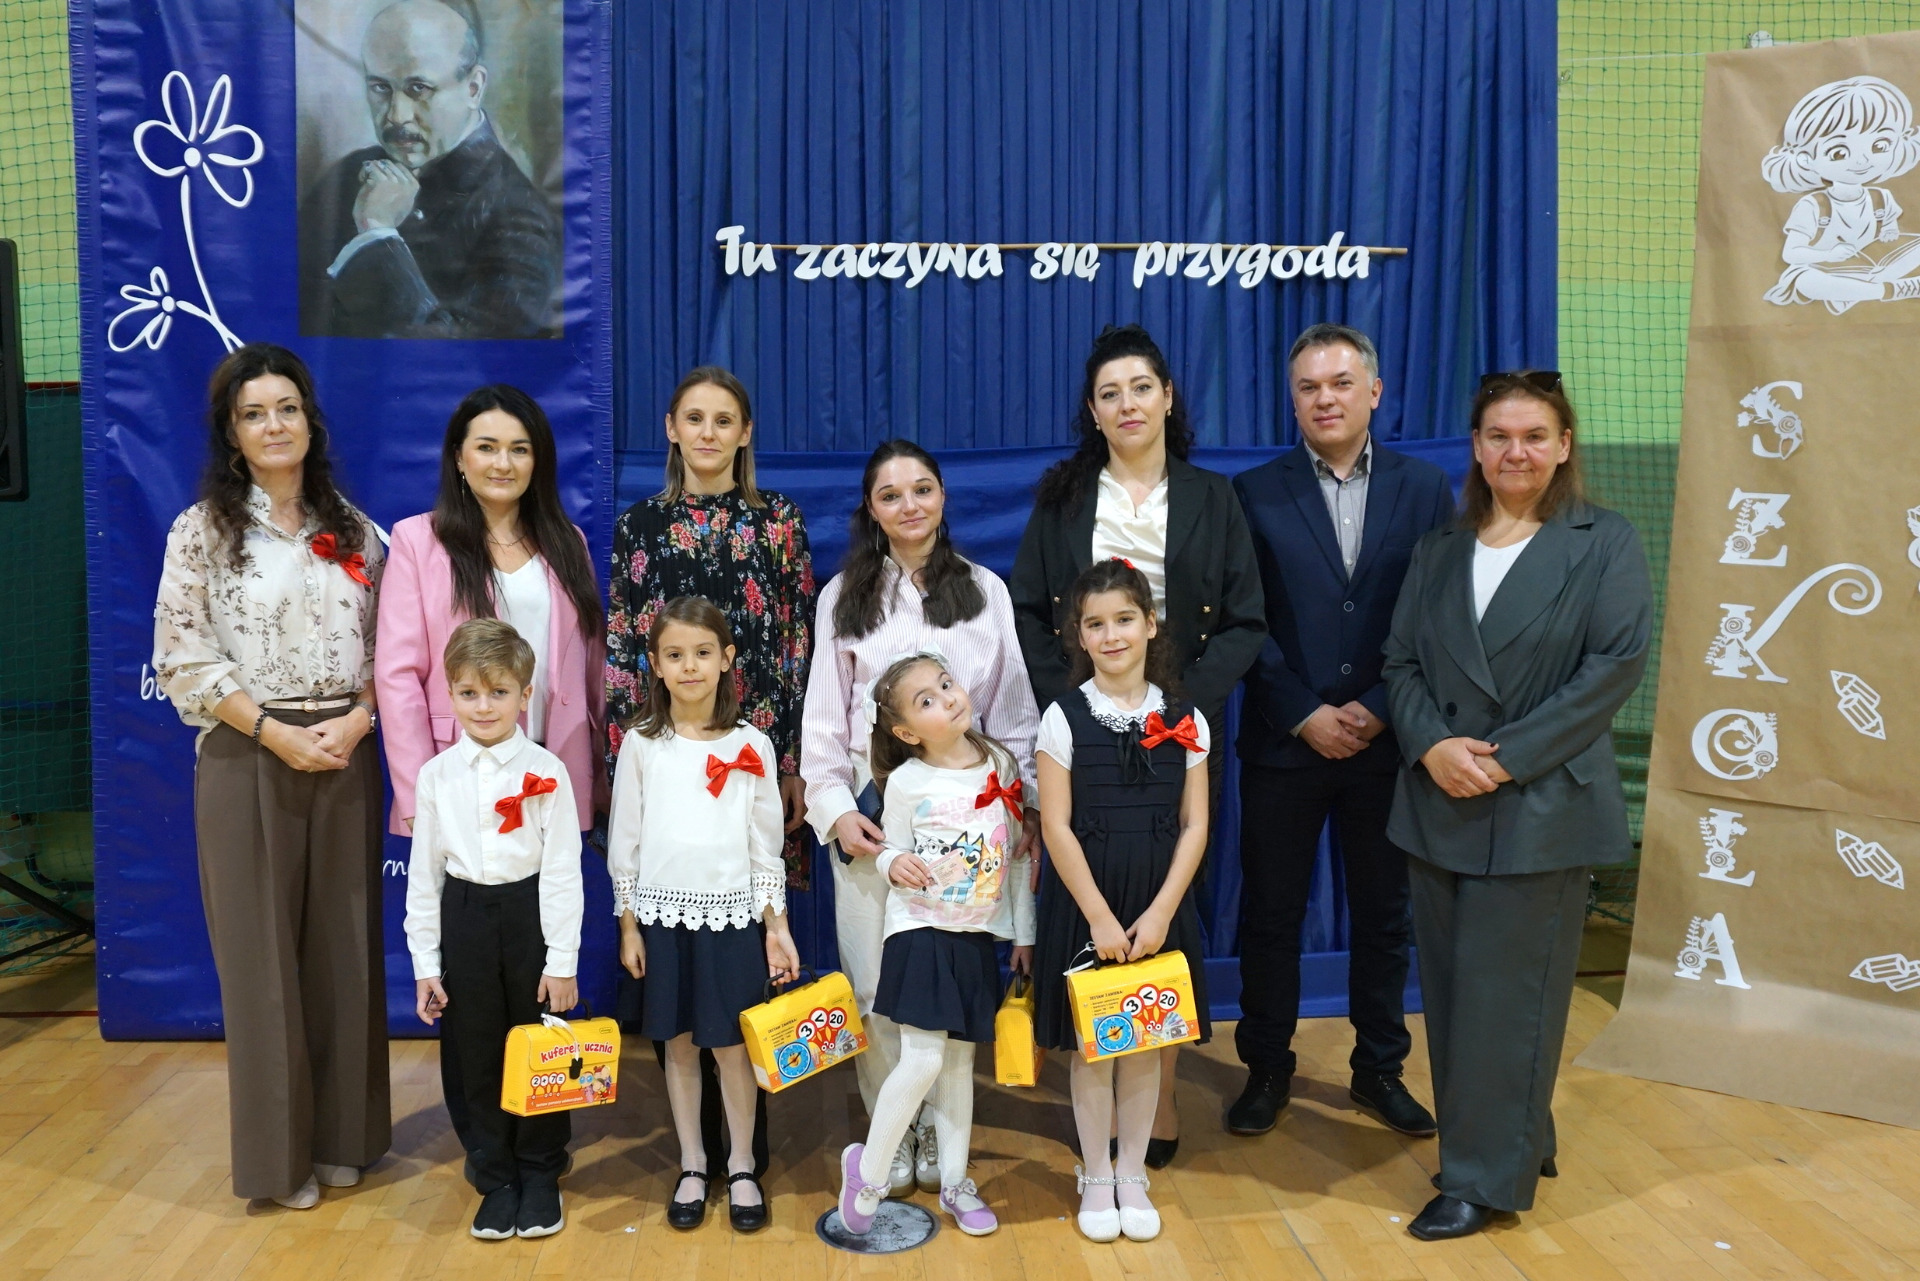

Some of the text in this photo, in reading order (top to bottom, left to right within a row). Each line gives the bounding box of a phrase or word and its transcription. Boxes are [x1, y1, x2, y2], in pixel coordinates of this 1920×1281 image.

[715, 225, 777, 277] Tu
[793, 242, 1004, 289] zaczyna
[1133, 231, 1370, 289] przygoda
[1160, 993, 1176, 1007] 20
[830, 1013, 844, 1025] 20
[584, 1041, 613, 1054] ucznia
